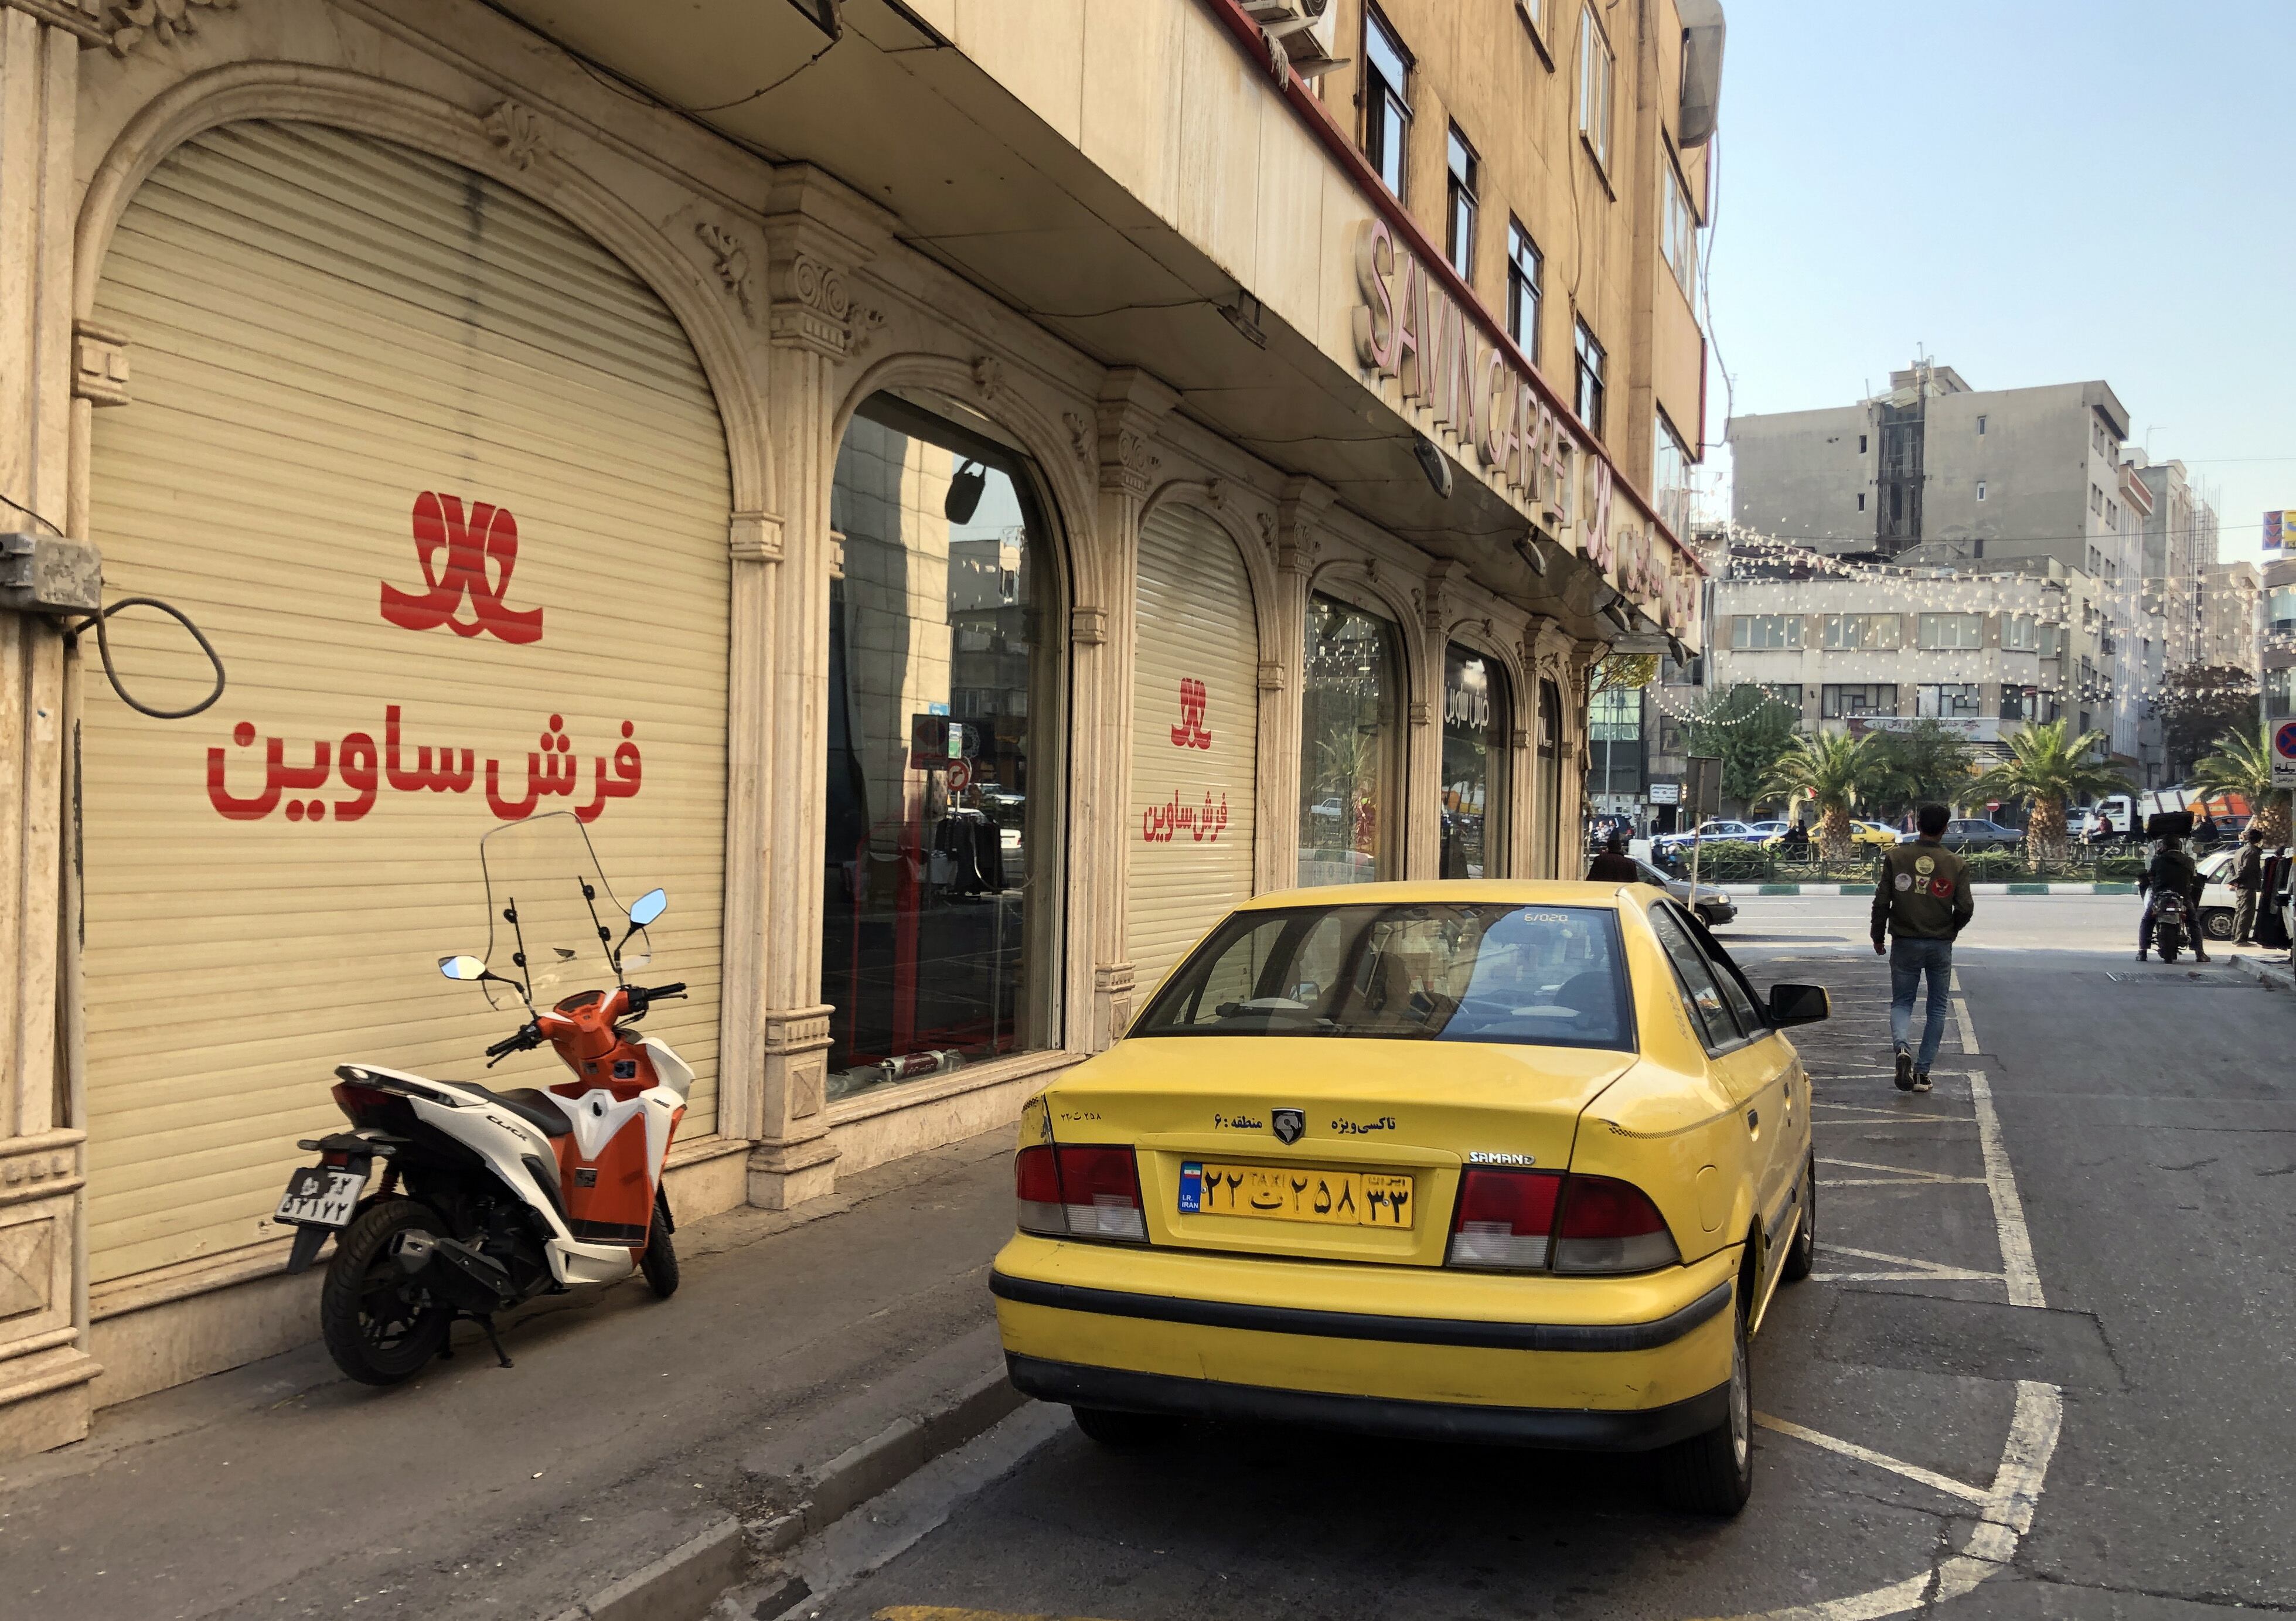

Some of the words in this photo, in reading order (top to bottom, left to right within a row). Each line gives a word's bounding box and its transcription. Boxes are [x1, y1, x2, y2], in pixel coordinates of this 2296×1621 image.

[1353, 218, 1478, 445] SAVIN
[1474, 348, 1579, 529] CARPET
[207, 705, 475, 822] ساوین
[486, 714, 642, 824] فرش
[1143, 789, 1193, 843] ساوین
[1193, 791, 1228, 843] فرش
[1469, 1151, 1535, 1165] SAMAND
[1181, 1201, 1199, 1210] IRAN
[1205, 1172, 1244, 1208] ۲۲
[1290, 1176, 1355, 1215] ۲۵۸
[1367, 1190, 1408, 1224] ۳۳
